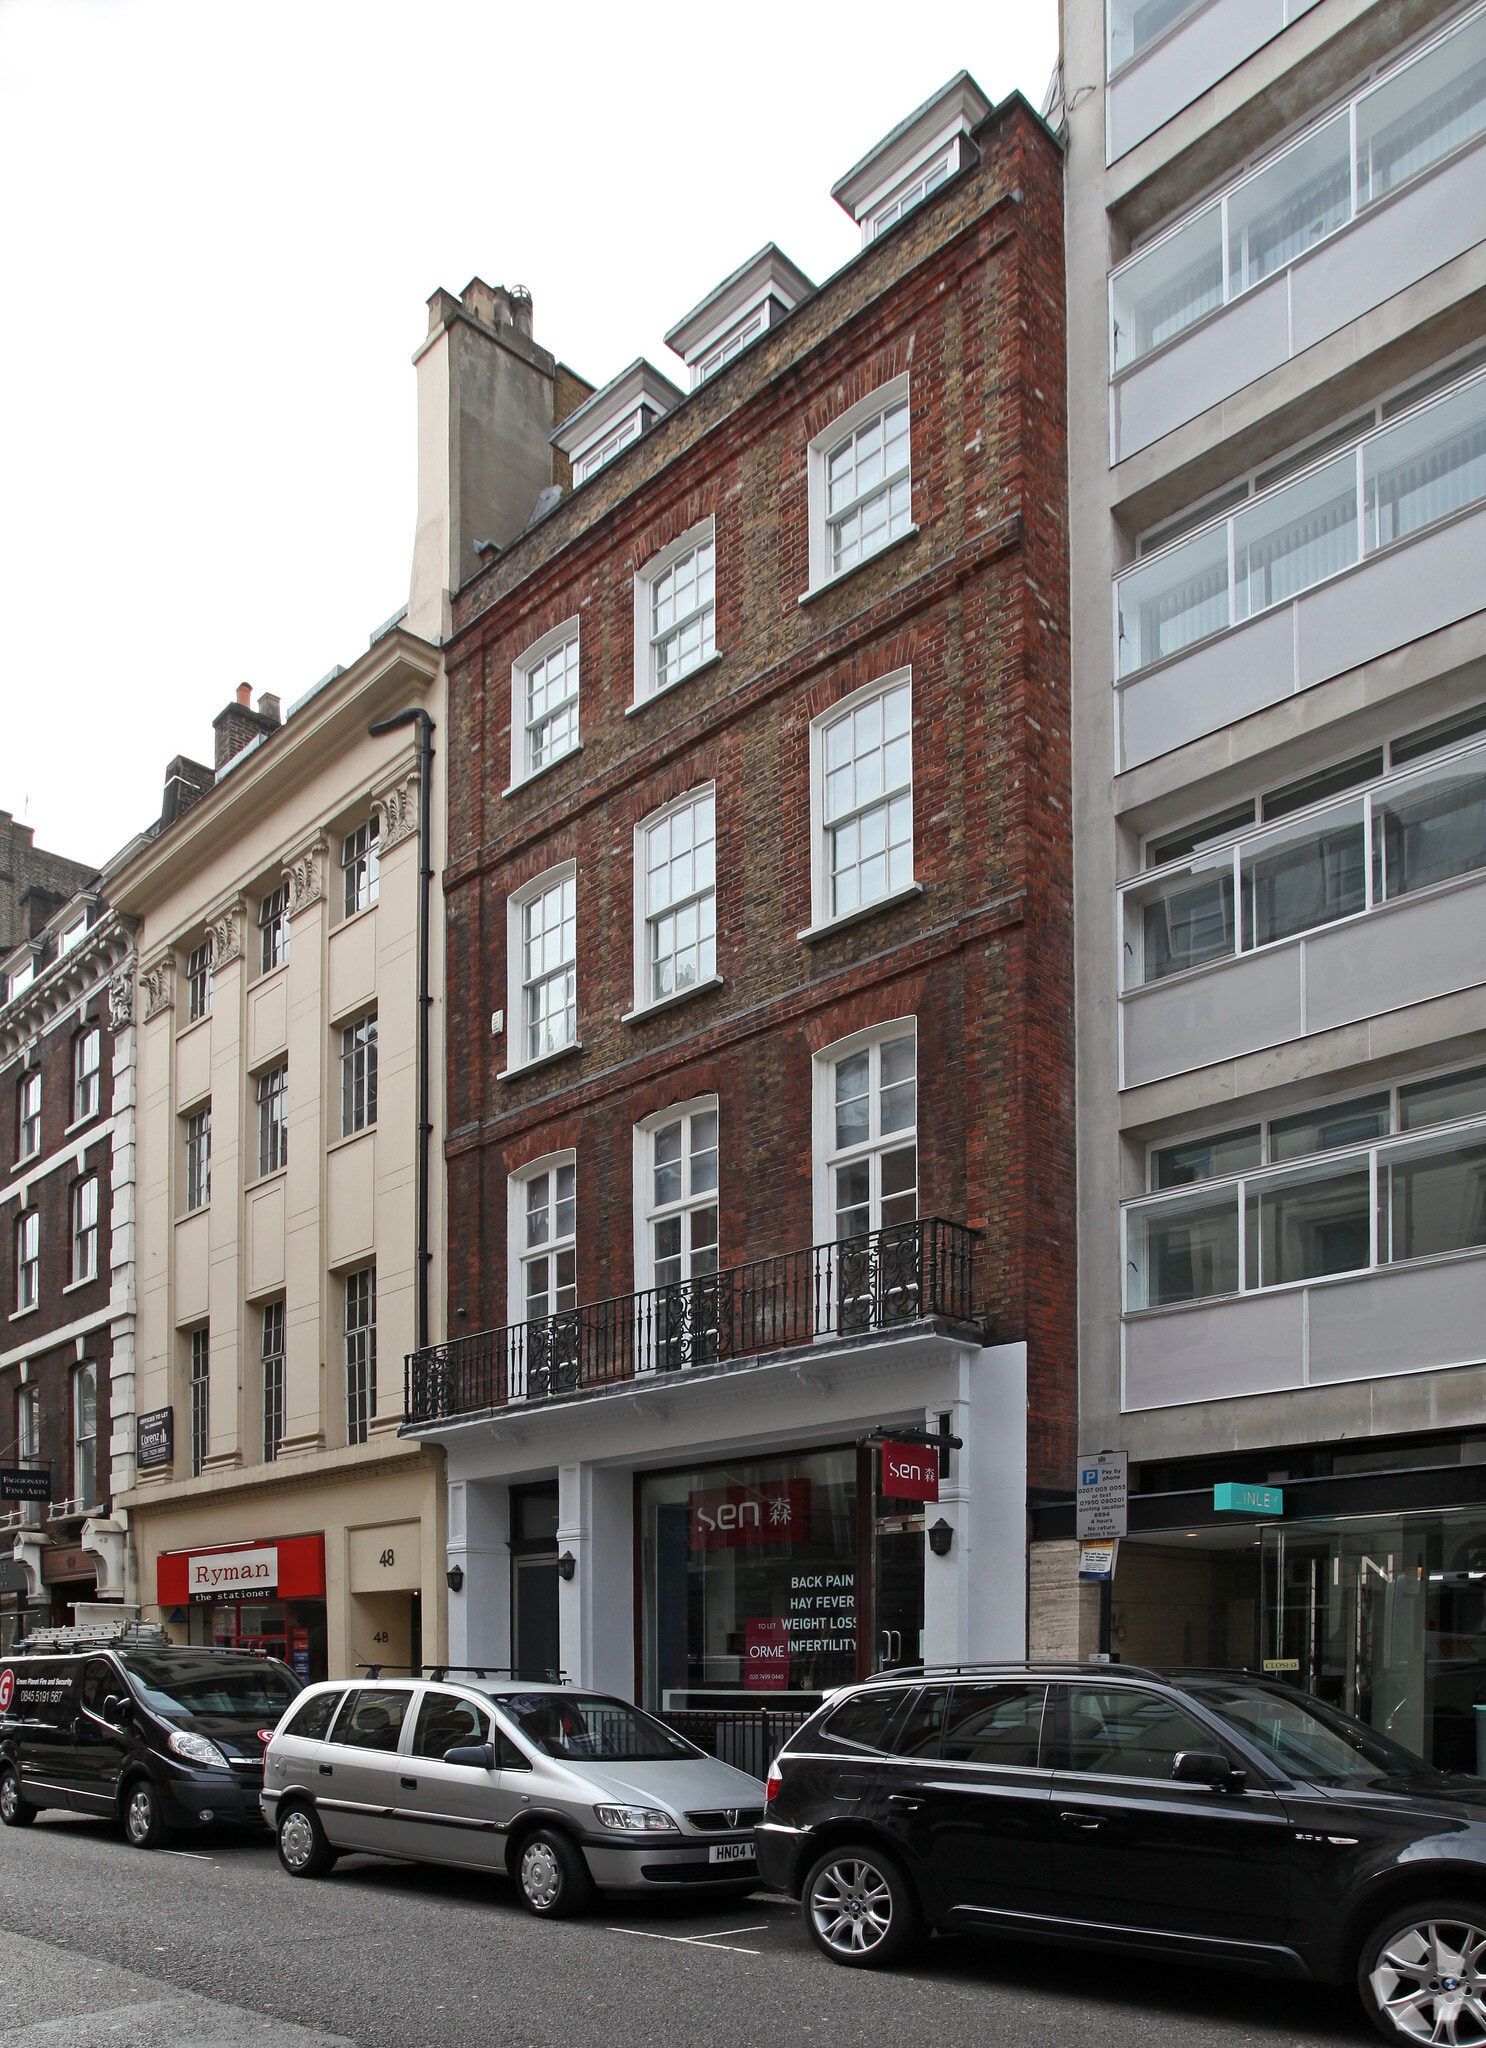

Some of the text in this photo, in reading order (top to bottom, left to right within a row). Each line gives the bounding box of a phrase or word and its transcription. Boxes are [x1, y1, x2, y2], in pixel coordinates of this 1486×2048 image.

[925, 1468, 935, 1482] 森
[1086, 1471, 1096, 1484] P
[1236, 1488, 1278, 1507] LINLEY
[769, 1498, 792, 1526] 森
[380, 1549, 394, 1567] 48
[195, 1563, 270, 1585] Ryman
[792, 1574, 854, 1588] BACK PAIN
[218, 1590, 270, 1600] stationer
[790, 1596, 854, 1609] HAY FEVER
[781, 1618, 826, 1630] WEIGHT
[373, 1632, 389, 1643] 48
[750, 1646, 785, 1658] ORME
[788, 1639, 856, 1652] INFERTILITY
[1265, 1661, 1297, 1669] CLOSED
[56, 1678, 72, 1687] Security
[21, 1691, 62, 1702] 0845 5191 567
[717, 1845, 746, 1860] HN04
